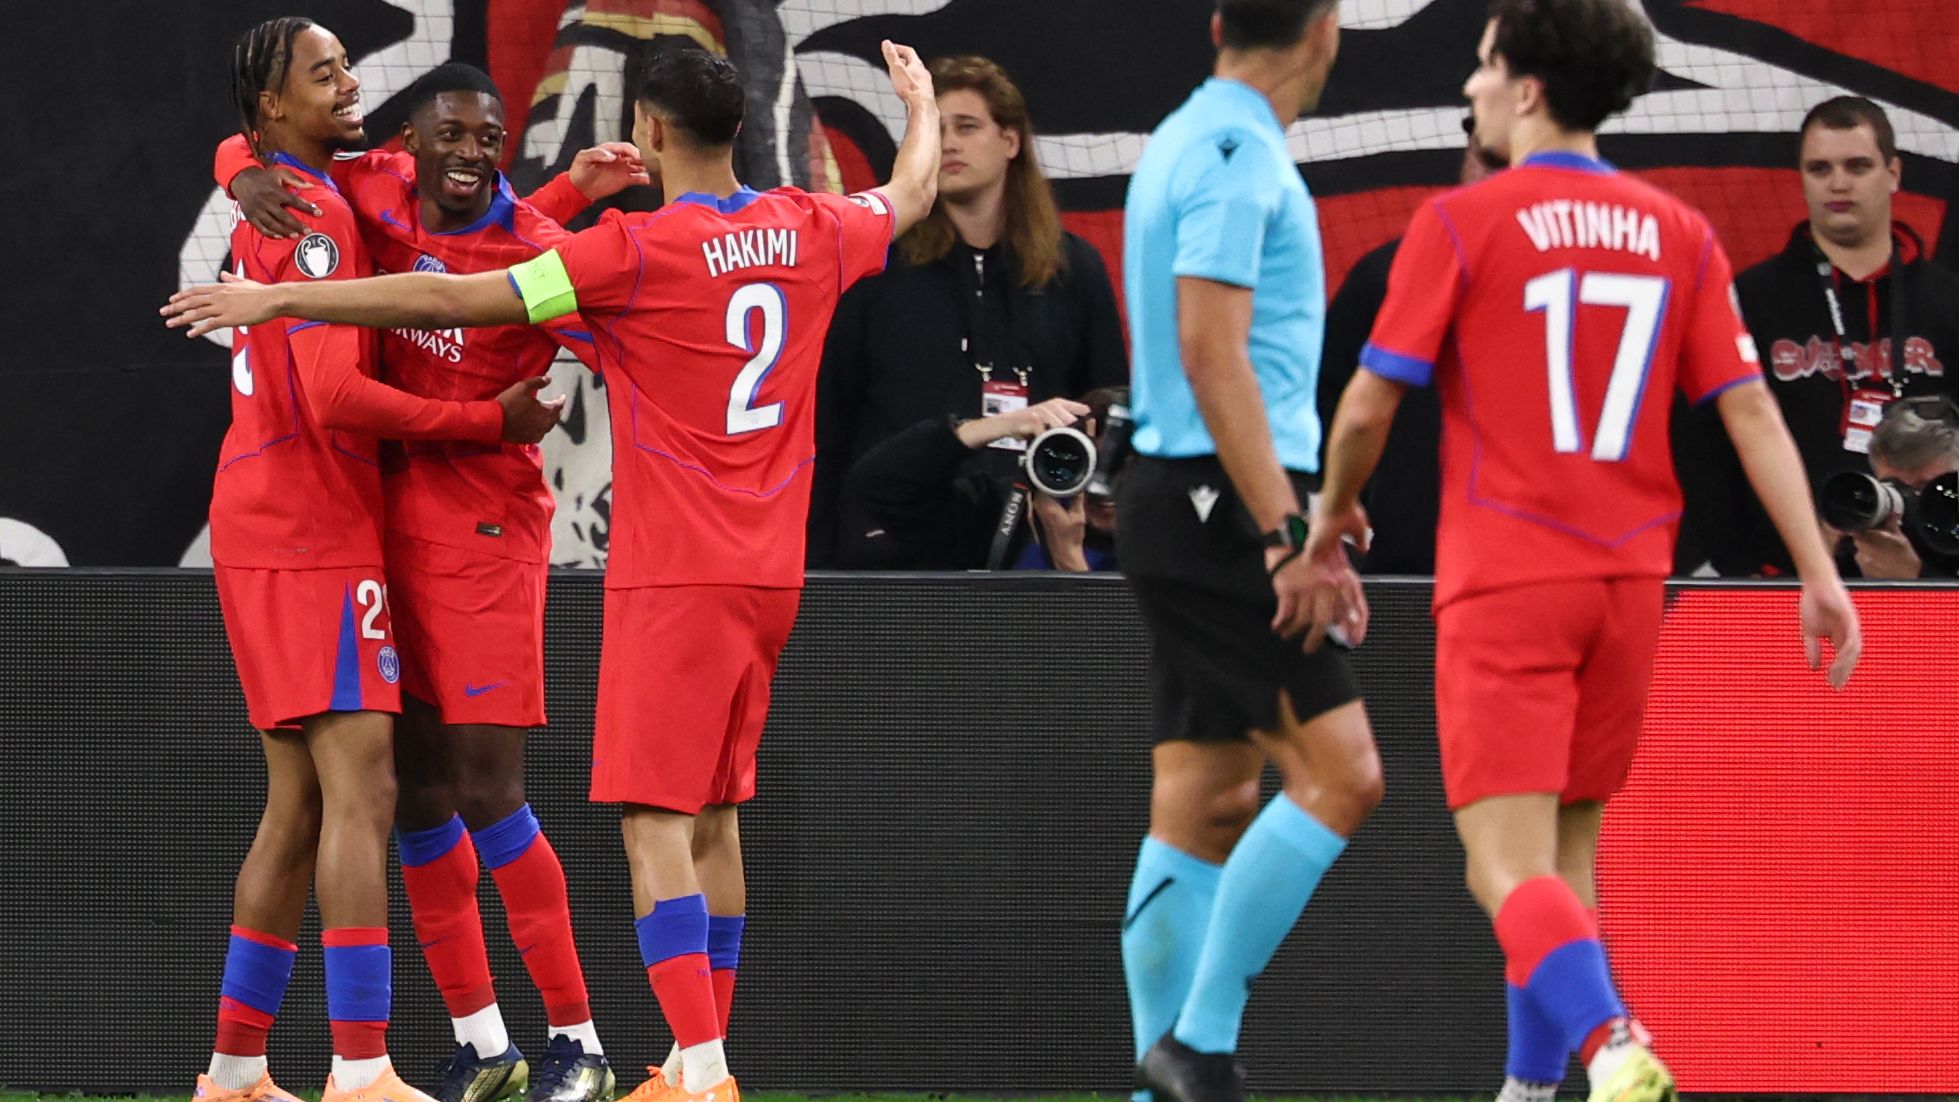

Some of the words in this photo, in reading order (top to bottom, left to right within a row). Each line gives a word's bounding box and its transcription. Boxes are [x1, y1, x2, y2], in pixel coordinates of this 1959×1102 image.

[702, 228, 797, 278] HAKIMI
[1516, 199, 1660, 262] VITINHA
[725, 282, 785, 435] 2
[1523, 267, 1668, 461] 17
[1001, 491, 1024, 536] SONY
[356, 579, 391, 640] 2
